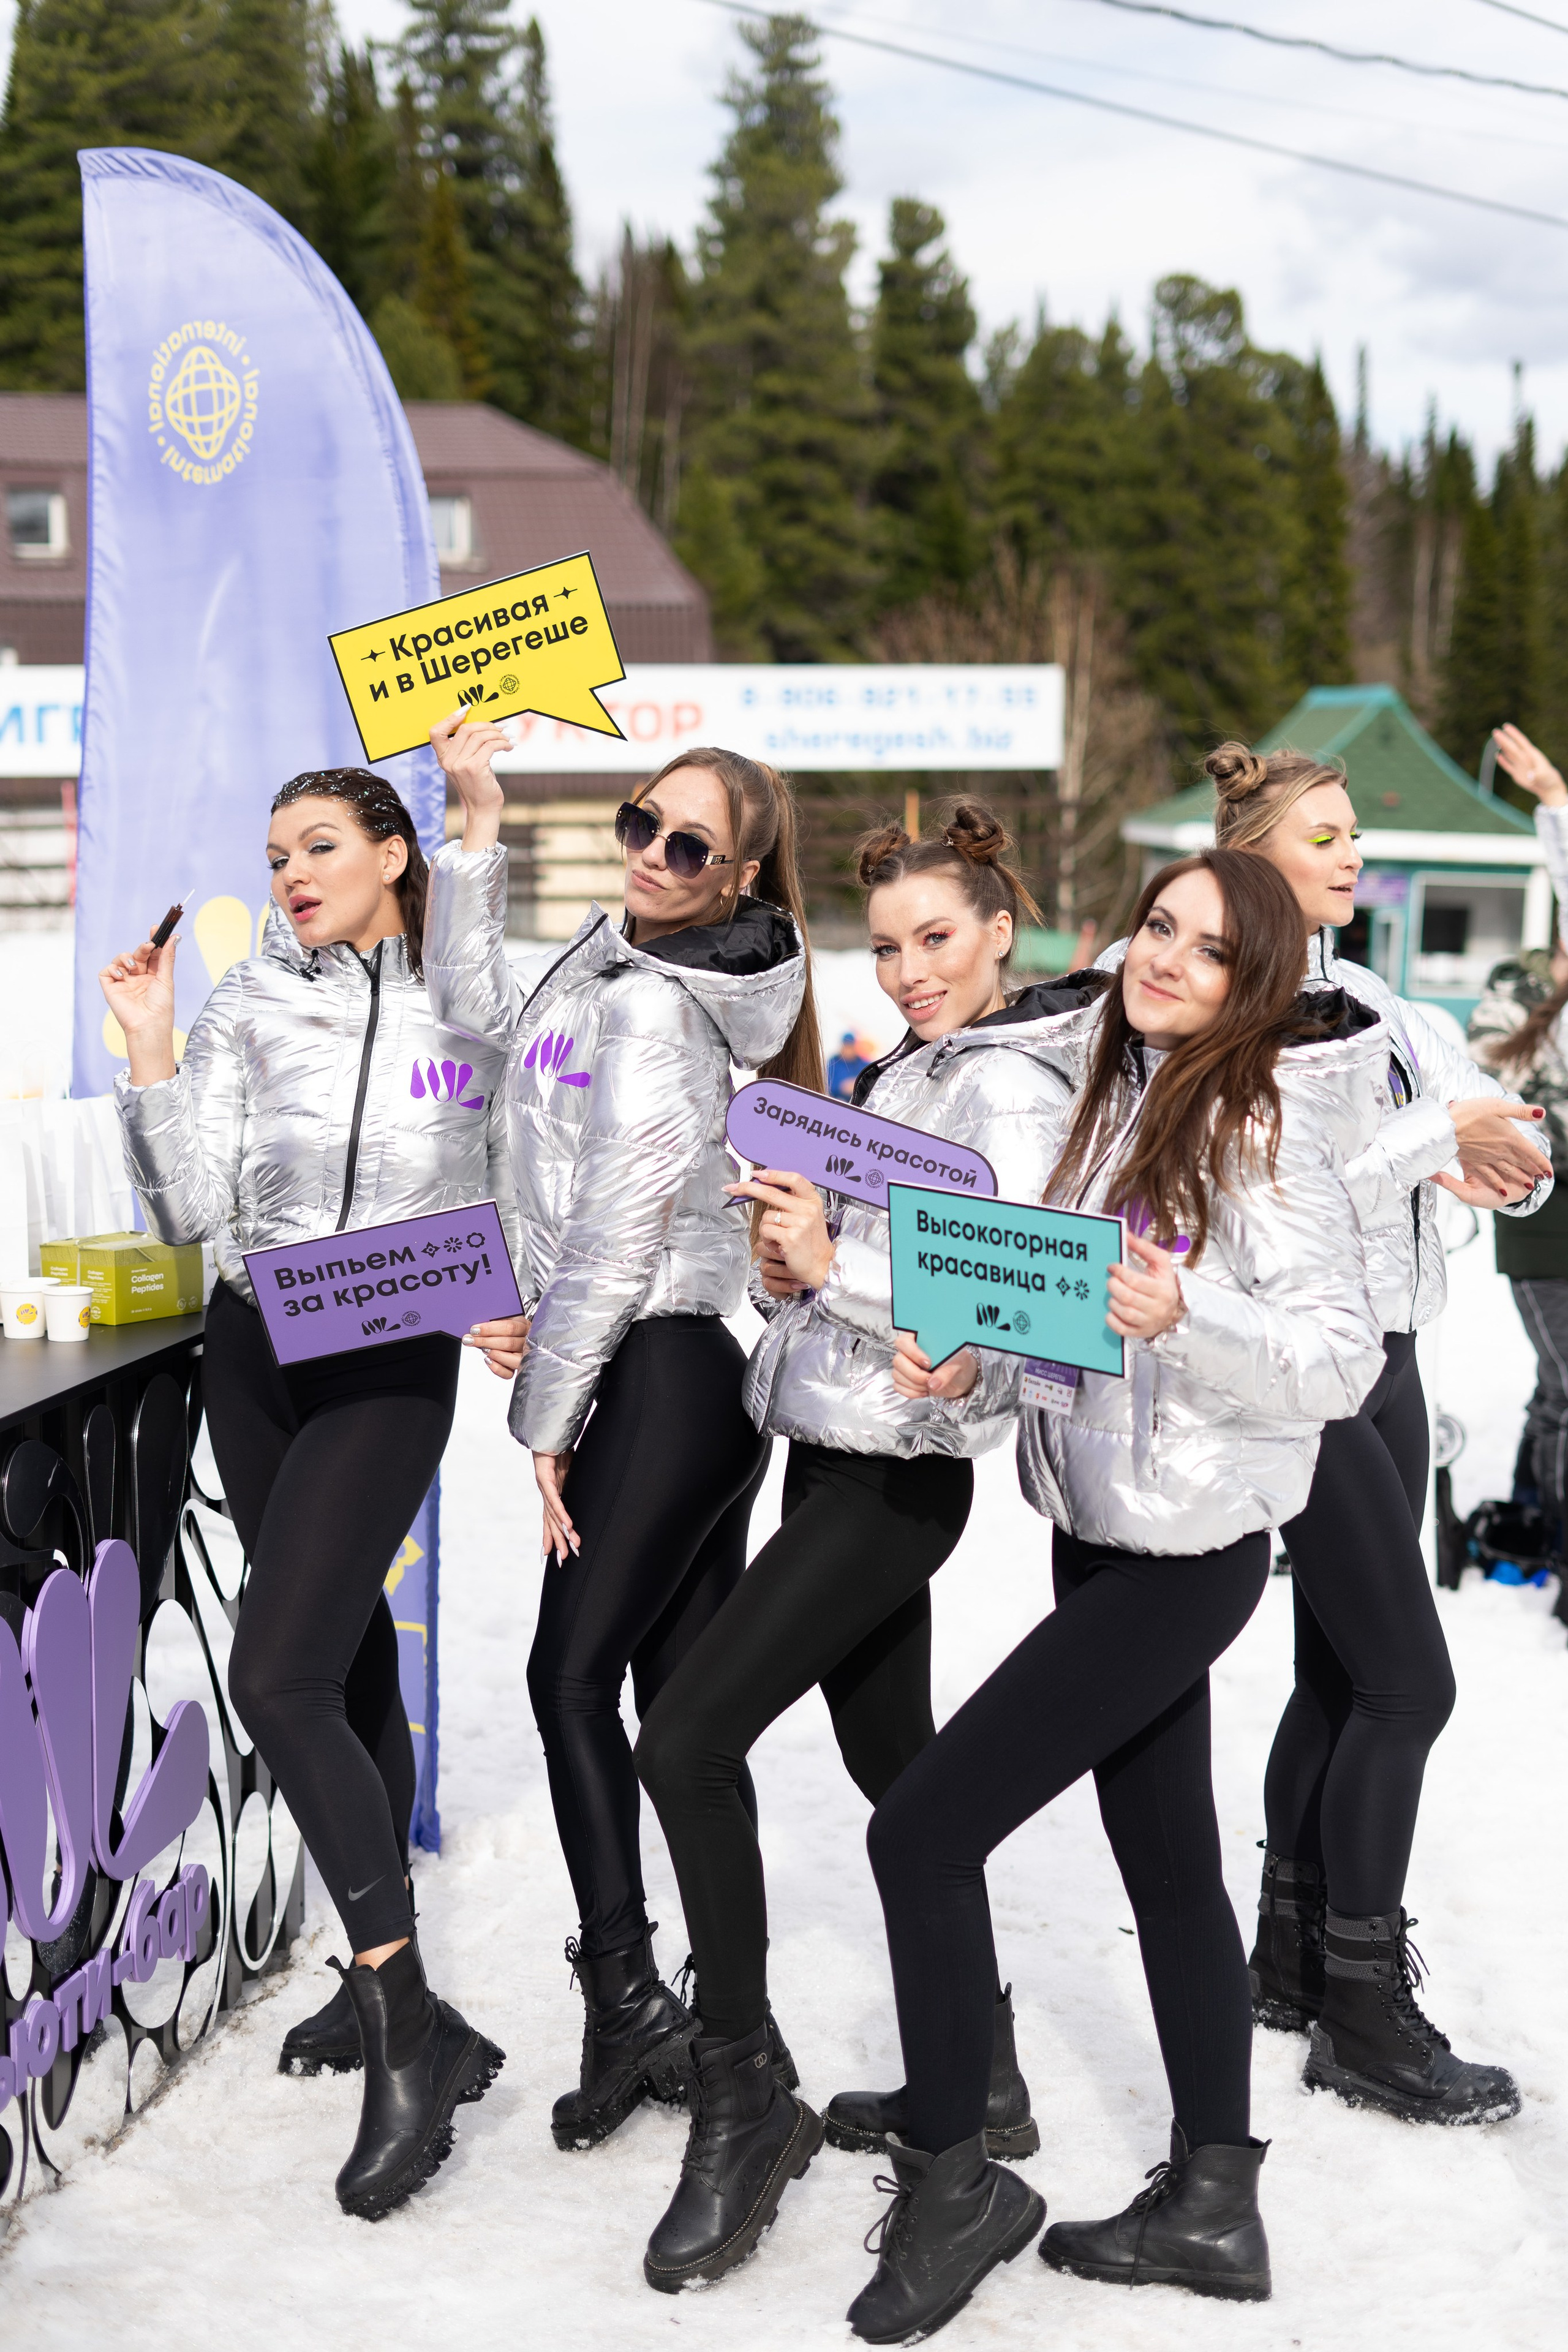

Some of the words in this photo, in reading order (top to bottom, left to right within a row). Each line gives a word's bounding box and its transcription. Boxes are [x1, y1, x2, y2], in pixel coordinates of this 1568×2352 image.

[389, 594, 549, 660] Красивая
[369, 680, 390, 703] и
[396, 673, 415, 694] в
[420, 615, 589, 685] Шерегеше
[753, 1096, 862, 1148] Зарядись
[866, 1137, 978, 1188] красотой
[917, 1209, 1088, 1262] Высокогорная
[131, 1273, 164, 1283] Collagen
[131, 1283, 164, 1294] Peptides
[273, 1245, 417, 1291] Выпьем
[282, 1294, 325, 1317] за
[333, 1253, 493, 1308] красоту!
[918, 1250, 1046, 1294] красавица
[1035, 1368, 1047, 1376] МИСС
[1047, 1371, 1066, 1382] ШЕРЕГЕШ
